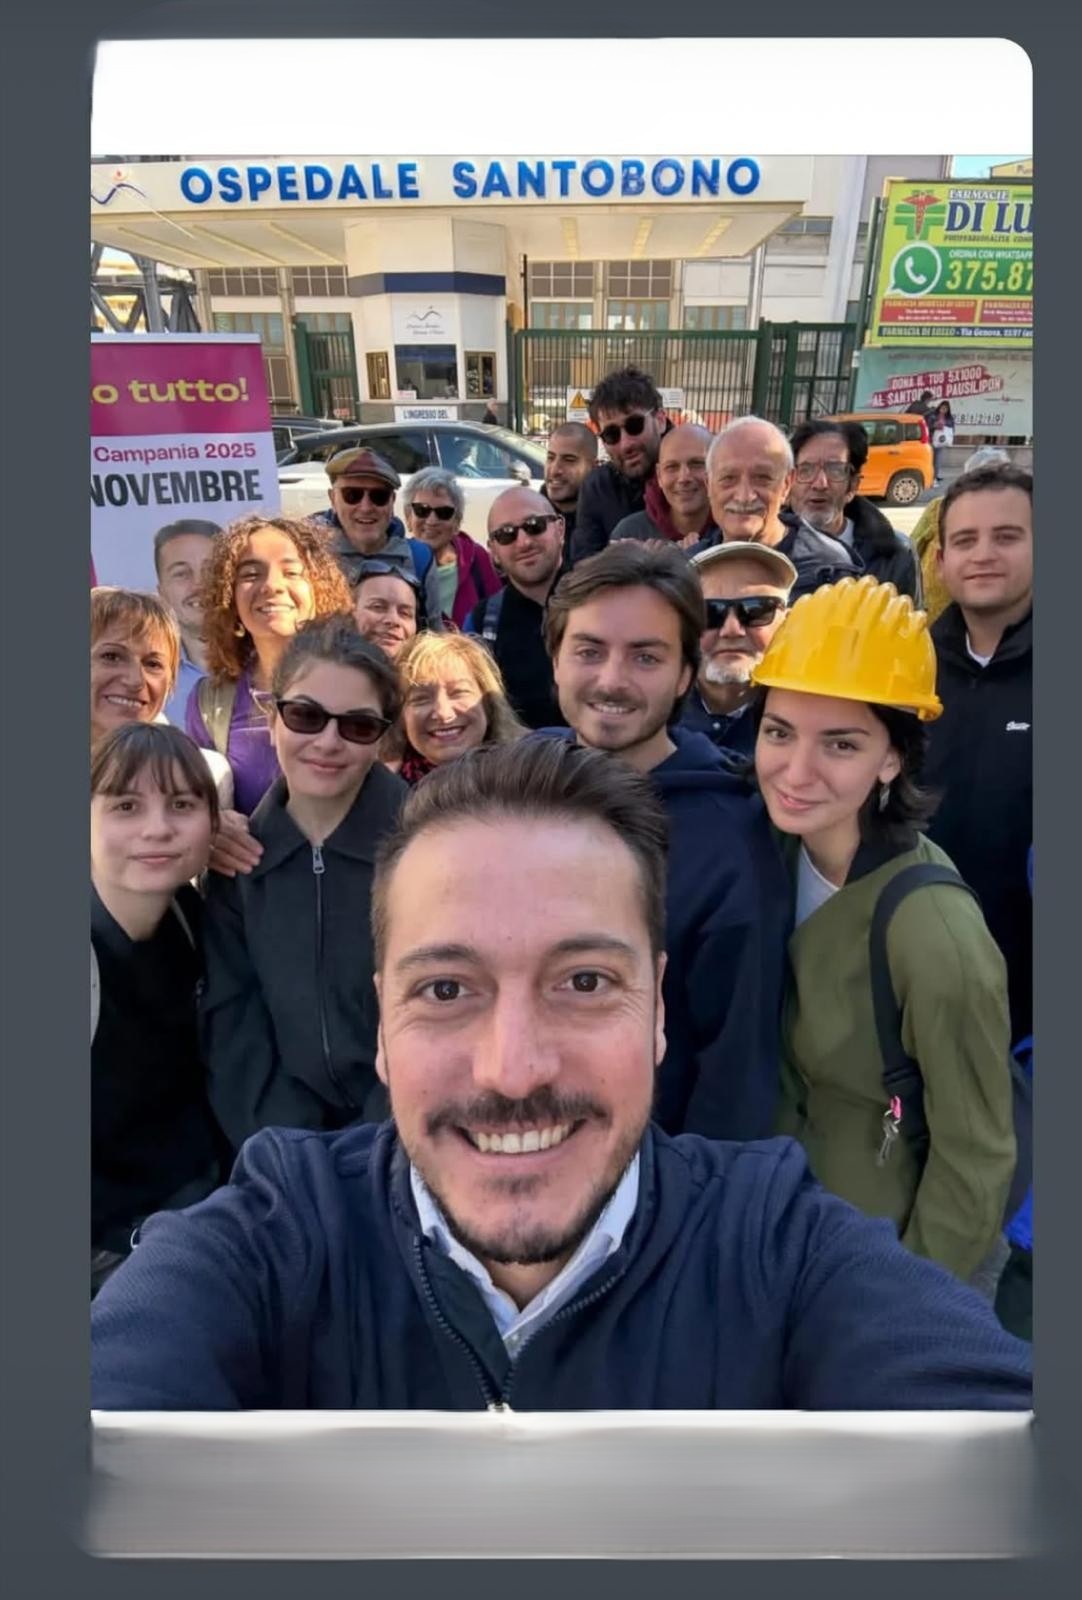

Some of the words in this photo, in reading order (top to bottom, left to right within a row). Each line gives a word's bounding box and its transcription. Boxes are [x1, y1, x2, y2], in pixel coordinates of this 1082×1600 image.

[180, 163, 420, 204] OSPEDALE
[452, 157, 761, 199] SANTOBONO
[949, 189, 1010, 200] FARMACIE
[945, 201, 986, 233] DI
[128, 377, 249, 403] tutto!
[891, 378, 915, 390] DONA
[929, 373, 945, 385] TUO
[872, 394, 887, 408] AL
[93, 443, 200, 465] Campania
[204, 441, 257, 460] 2025
[91, 468, 264, 508] NOVEMBRE
